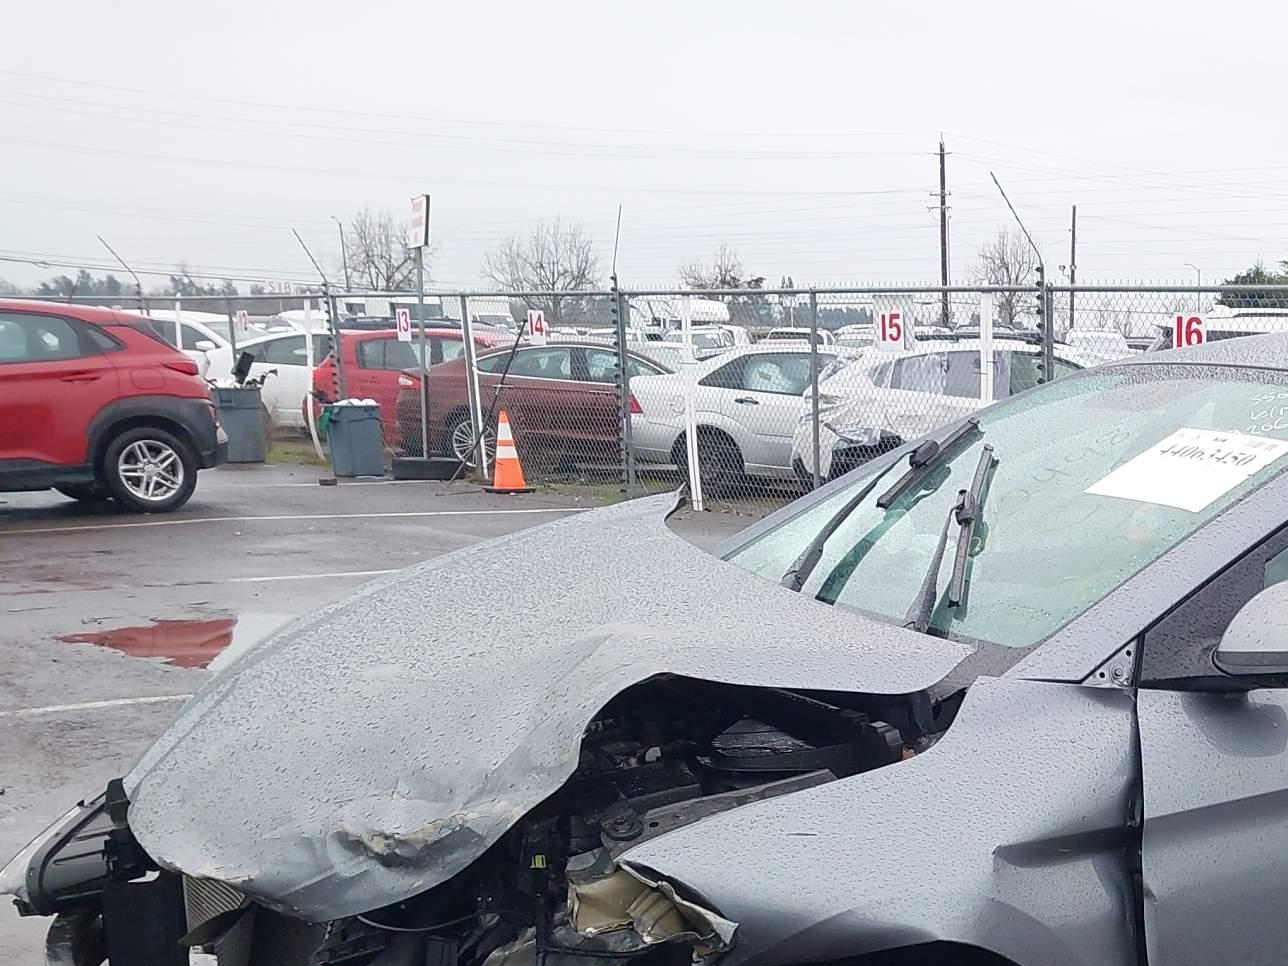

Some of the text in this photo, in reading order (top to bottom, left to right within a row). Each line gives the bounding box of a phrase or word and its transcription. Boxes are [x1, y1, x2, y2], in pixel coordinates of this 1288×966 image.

[397, 311, 409, 332] 13
[529, 313, 544, 336] 14
[881, 313, 902, 342] 15
[1176, 315, 1203, 348] 16
